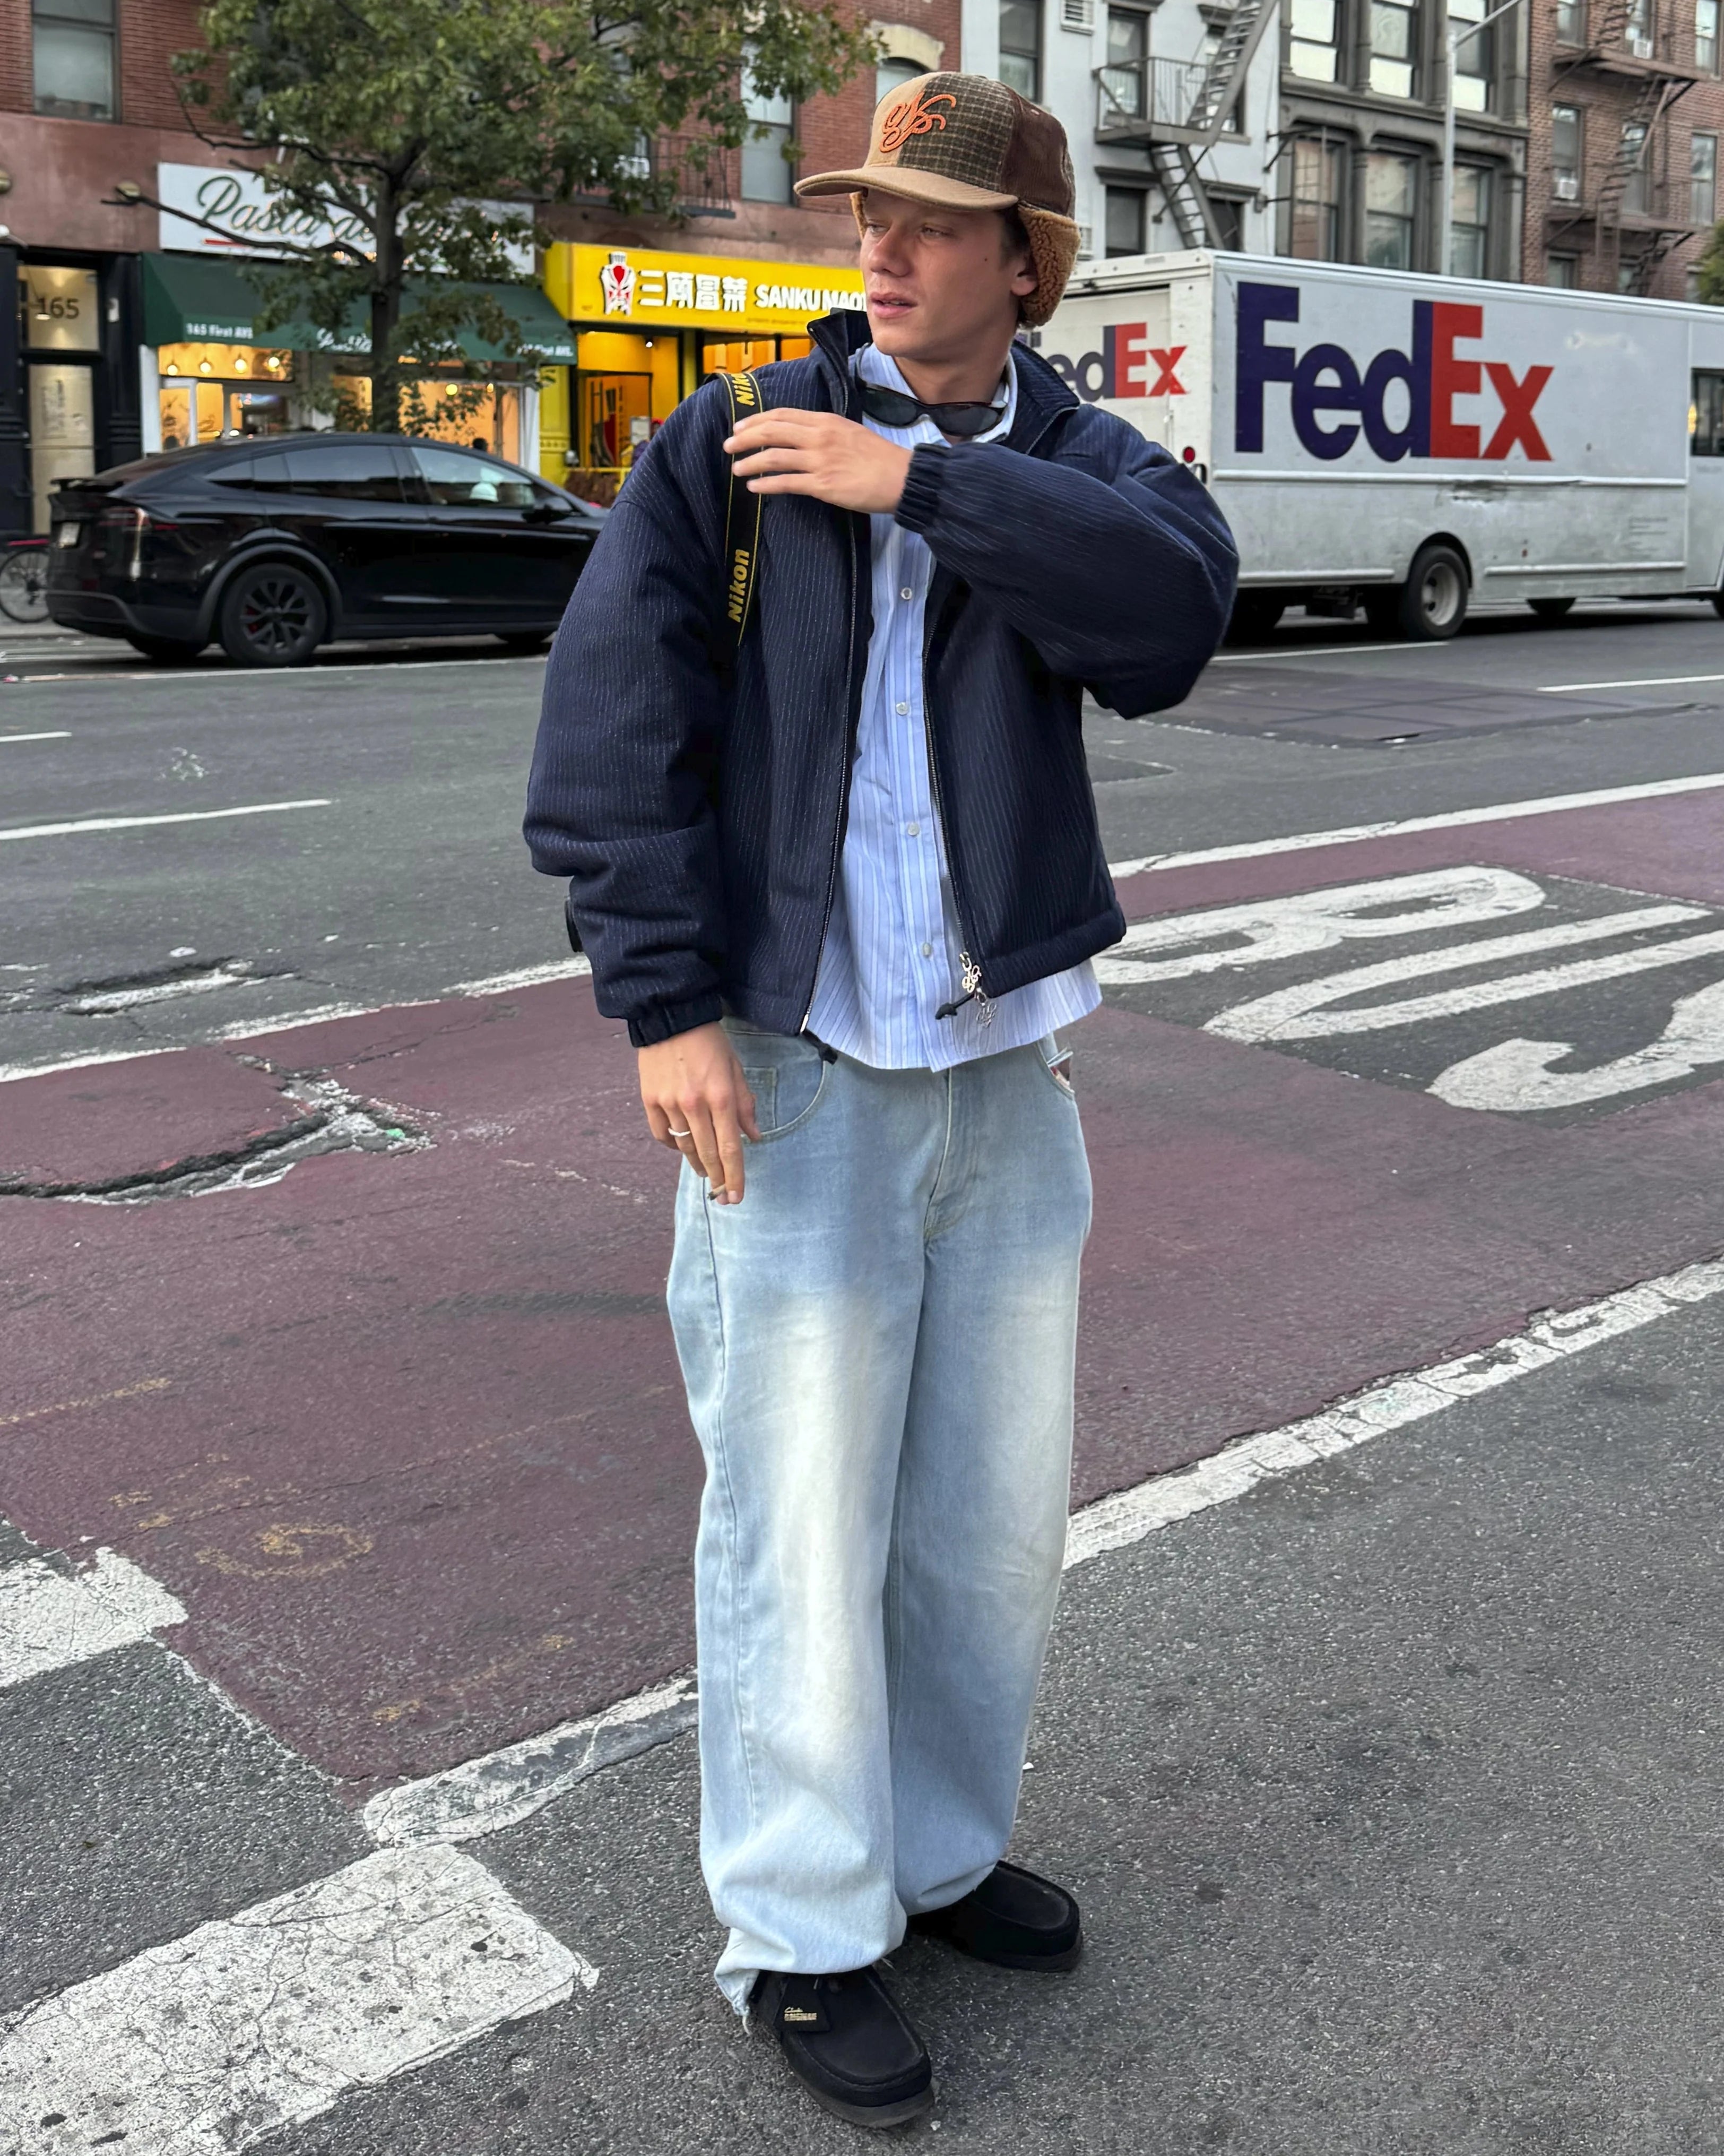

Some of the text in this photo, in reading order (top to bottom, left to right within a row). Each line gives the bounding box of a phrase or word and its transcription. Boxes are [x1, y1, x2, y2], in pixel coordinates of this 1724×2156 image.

[38, 296, 80, 320] 165
[756, 284, 867, 312] SANKU MAO
[1012, 322, 1188, 402] edEx
[1235, 281, 1554, 462] FedEx
[727, 548, 750, 623] Nikon
